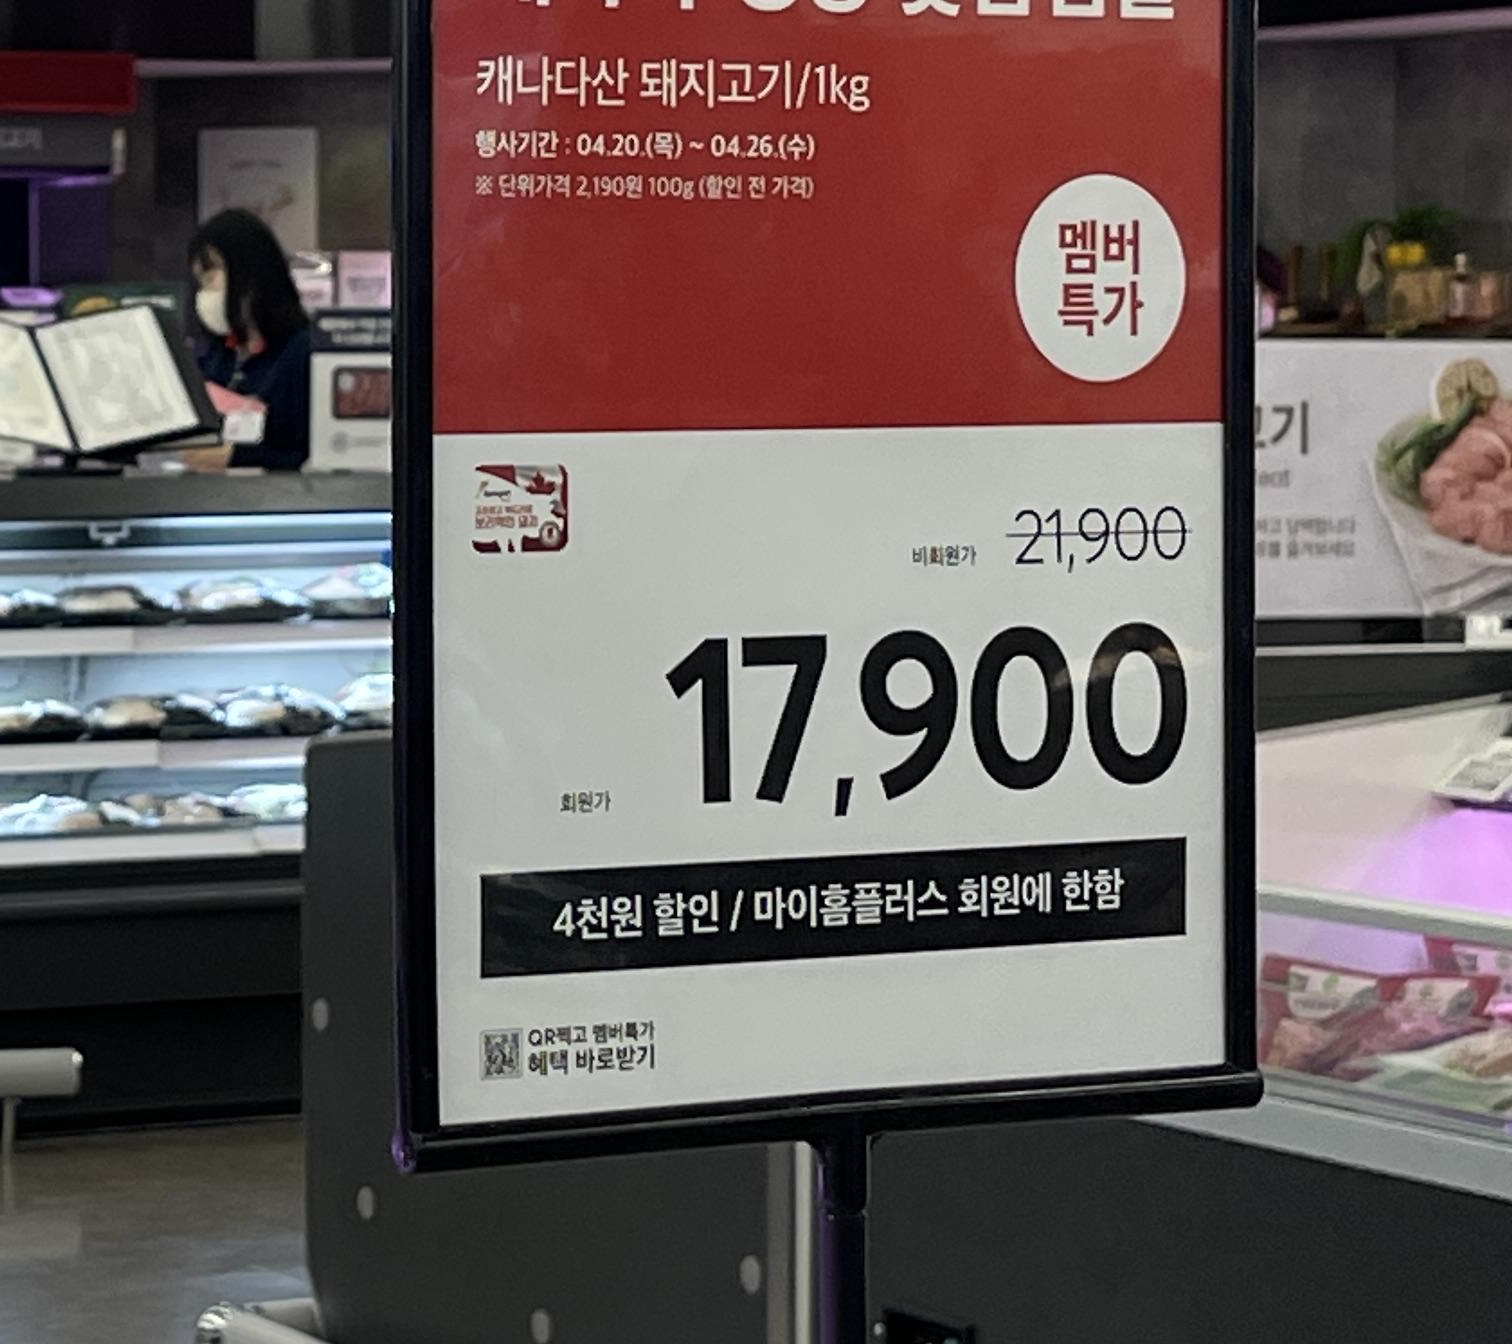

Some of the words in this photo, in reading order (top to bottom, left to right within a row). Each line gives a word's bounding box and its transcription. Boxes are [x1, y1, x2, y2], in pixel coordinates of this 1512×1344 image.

[476, 55, 630, 108] 캐나다산
[639, 58, 871, 113] 돼지고기/1kg
[475, 129, 559, 159] 행사기간
[710, 133, 815, 161] 04.26.(수)
[498, 174, 571, 198] 단위가격
[648, 176, 694, 200] 100g
[1058, 220, 1141, 275] 멤버
[1057, 280, 1144, 337] 특가
[1013, 506, 1187, 574] 21,900
[665, 622, 1188, 817] 17,900
[559, 790, 612, 814] 회원가
[553, 895, 644, 940] 4천원
[653, 890, 721, 936] 할인
[753, 877, 948, 932] 마이홈플러스
[958, 872, 1053, 916] 회원에
[1061, 868, 1126, 912] 한함
[575, 1044, 656, 1073] 바로받기
